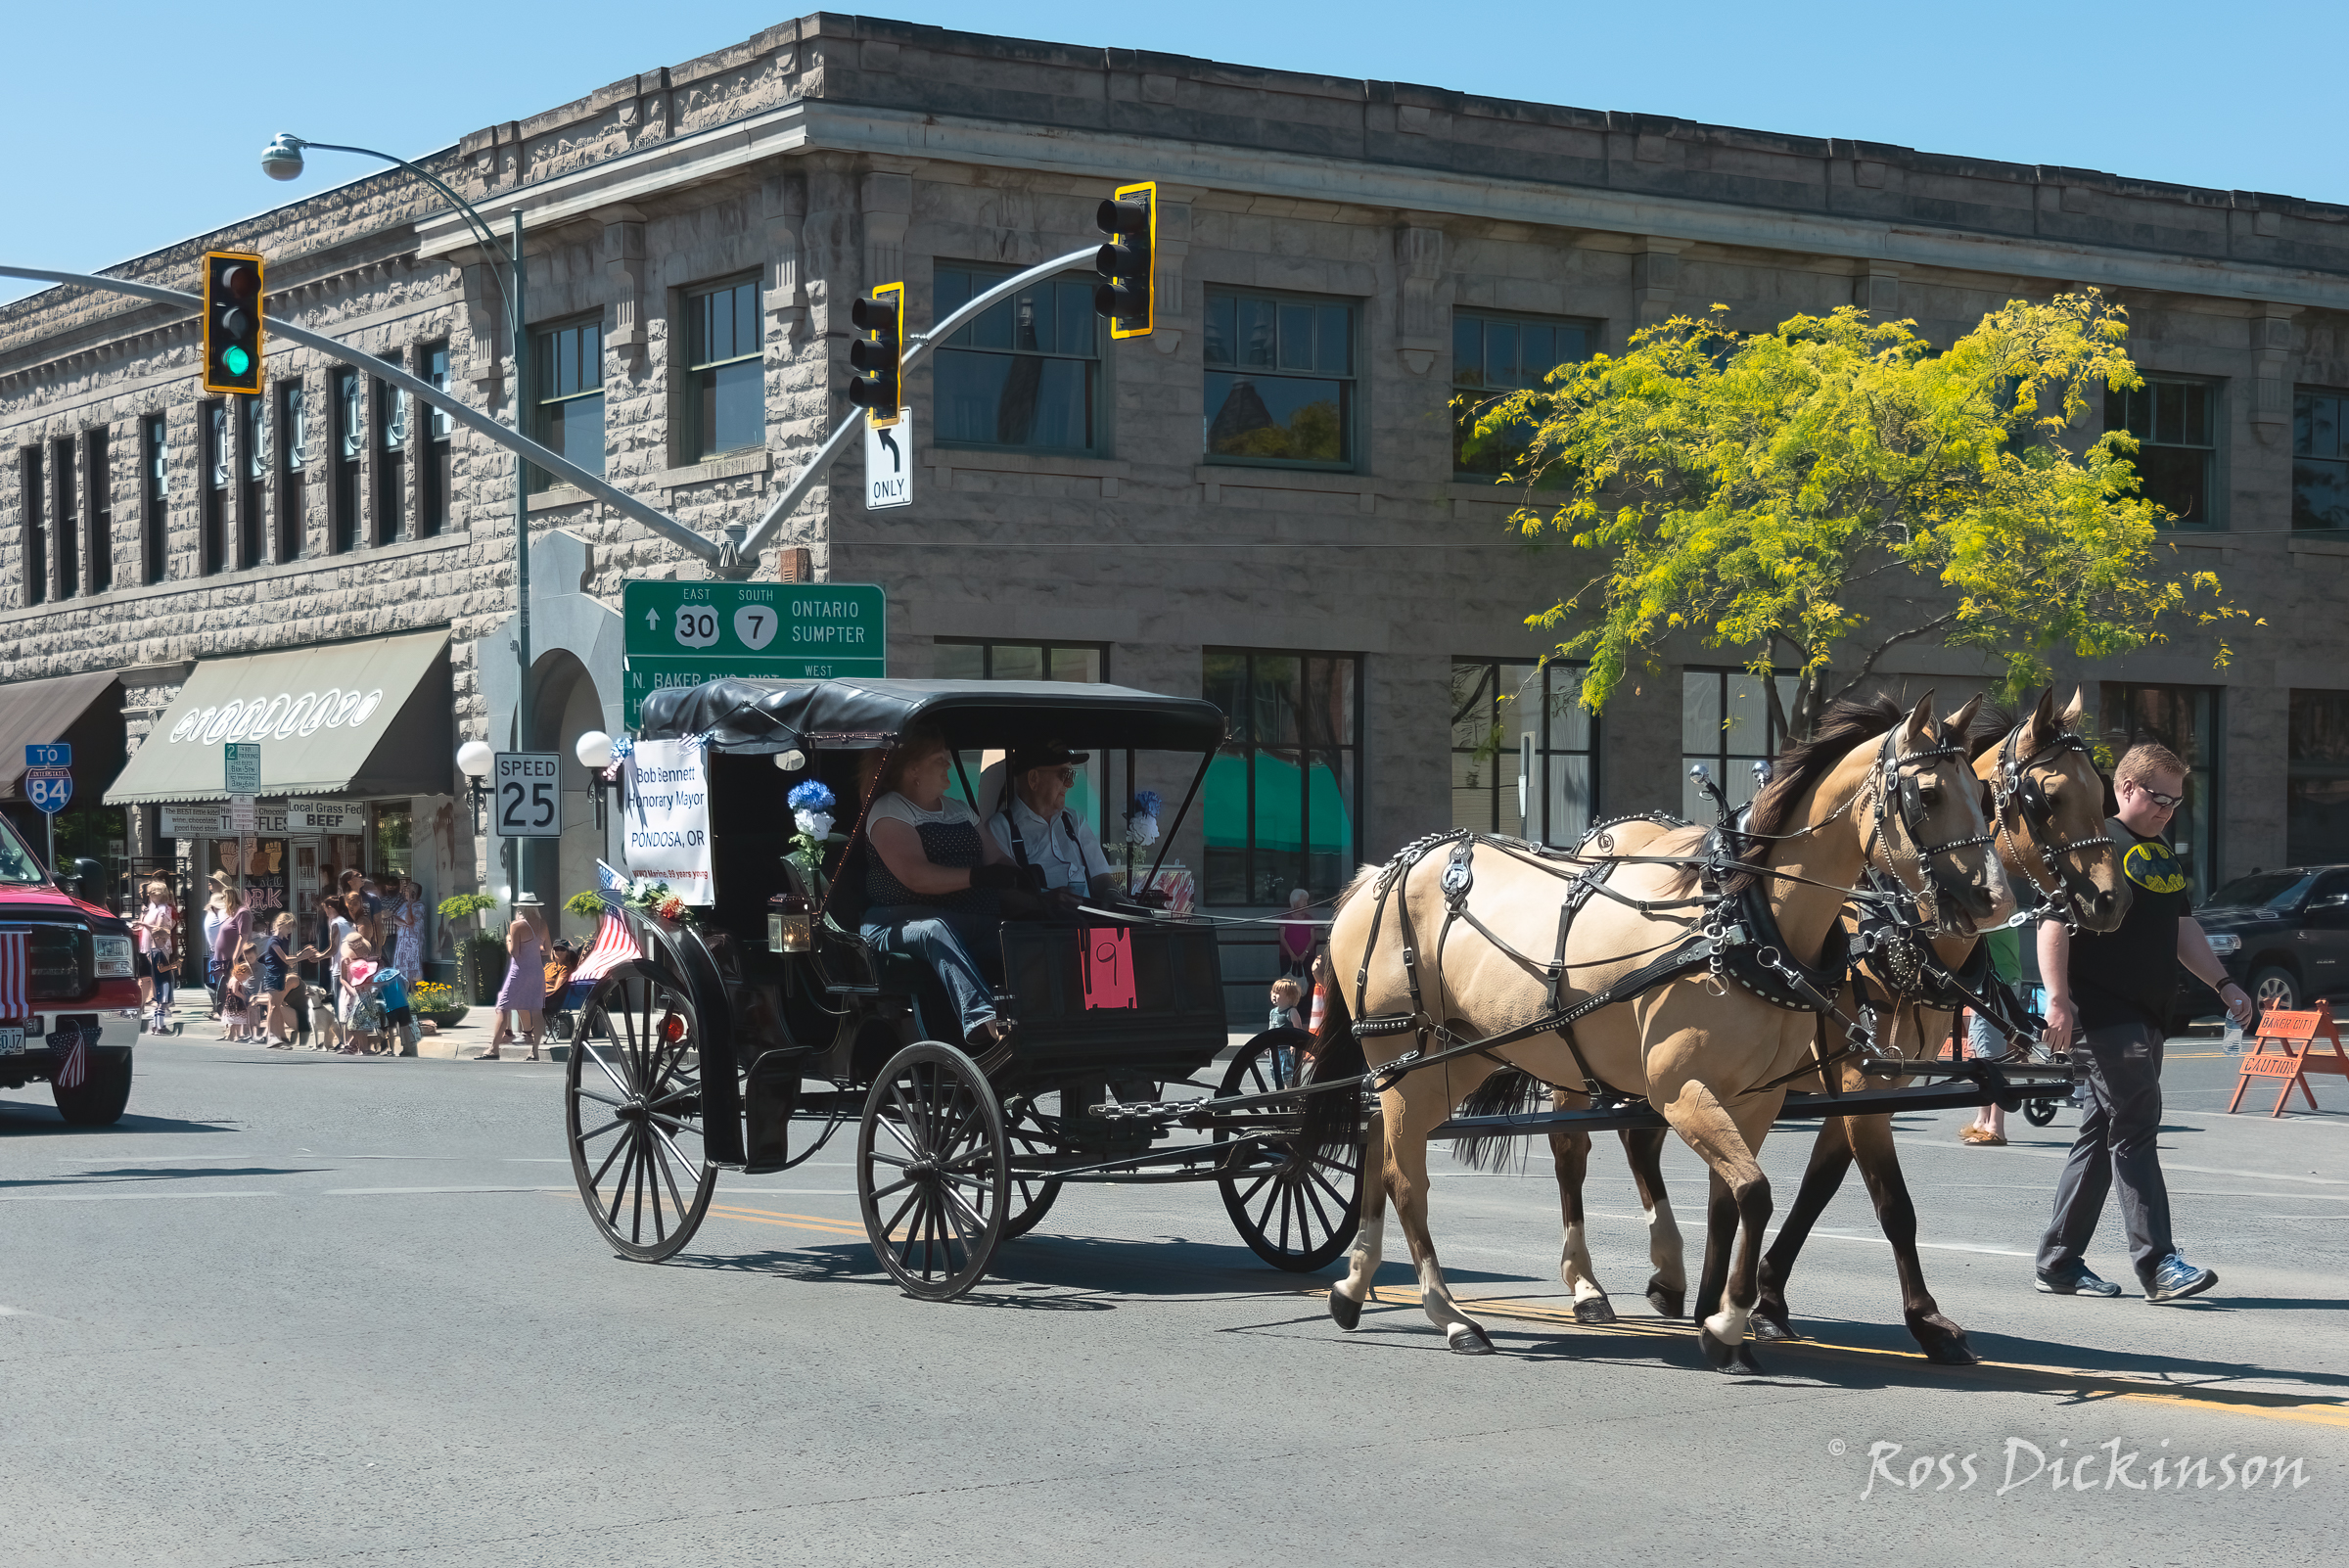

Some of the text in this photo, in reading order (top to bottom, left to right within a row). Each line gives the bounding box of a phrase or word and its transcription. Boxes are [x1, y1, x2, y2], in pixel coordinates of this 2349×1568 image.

[873, 478, 904, 499] ONLY
[683, 588, 711, 600] EAST
[738, 589, 774, 602] SOUTH
[792, 600, 859, 619] ONTARIO
[679, 614, 714, 638] 30
[747, 615, 764, 640] 7
[792, 625, 865, 643] SUMPTER
[805, 665, 832, 677] WEST
[632, 672, 646, 689] N.
[654, 672, 702, 688] BAKER
[36, 749, 59, 761] TO
[227, 745, 236, 759] 2
[500, 761, 556, 776] SPEED
[636, 766, 695, 783] Bob Bennett
[32, 779, 68, 805] 84
[627, 791, 705, 810] Honorary Mayor
[258, 807, 287, 816] Chocola
[289, 801, 362, 814] Local Grass Fed
[502, 781, 555, 828] 25
[306, 813, 344, 827] BEEF
[631, 830, 705, 849] PONDOSA, OR
[675, 870, 692, 880] years
[692, 870, 709, 880] young
[1096, 942, 1118, 987] 9
[2261, 1016, 2315, 1030] BAKER CITY
[2244, 1057, 2298, 1074] CAUTION
